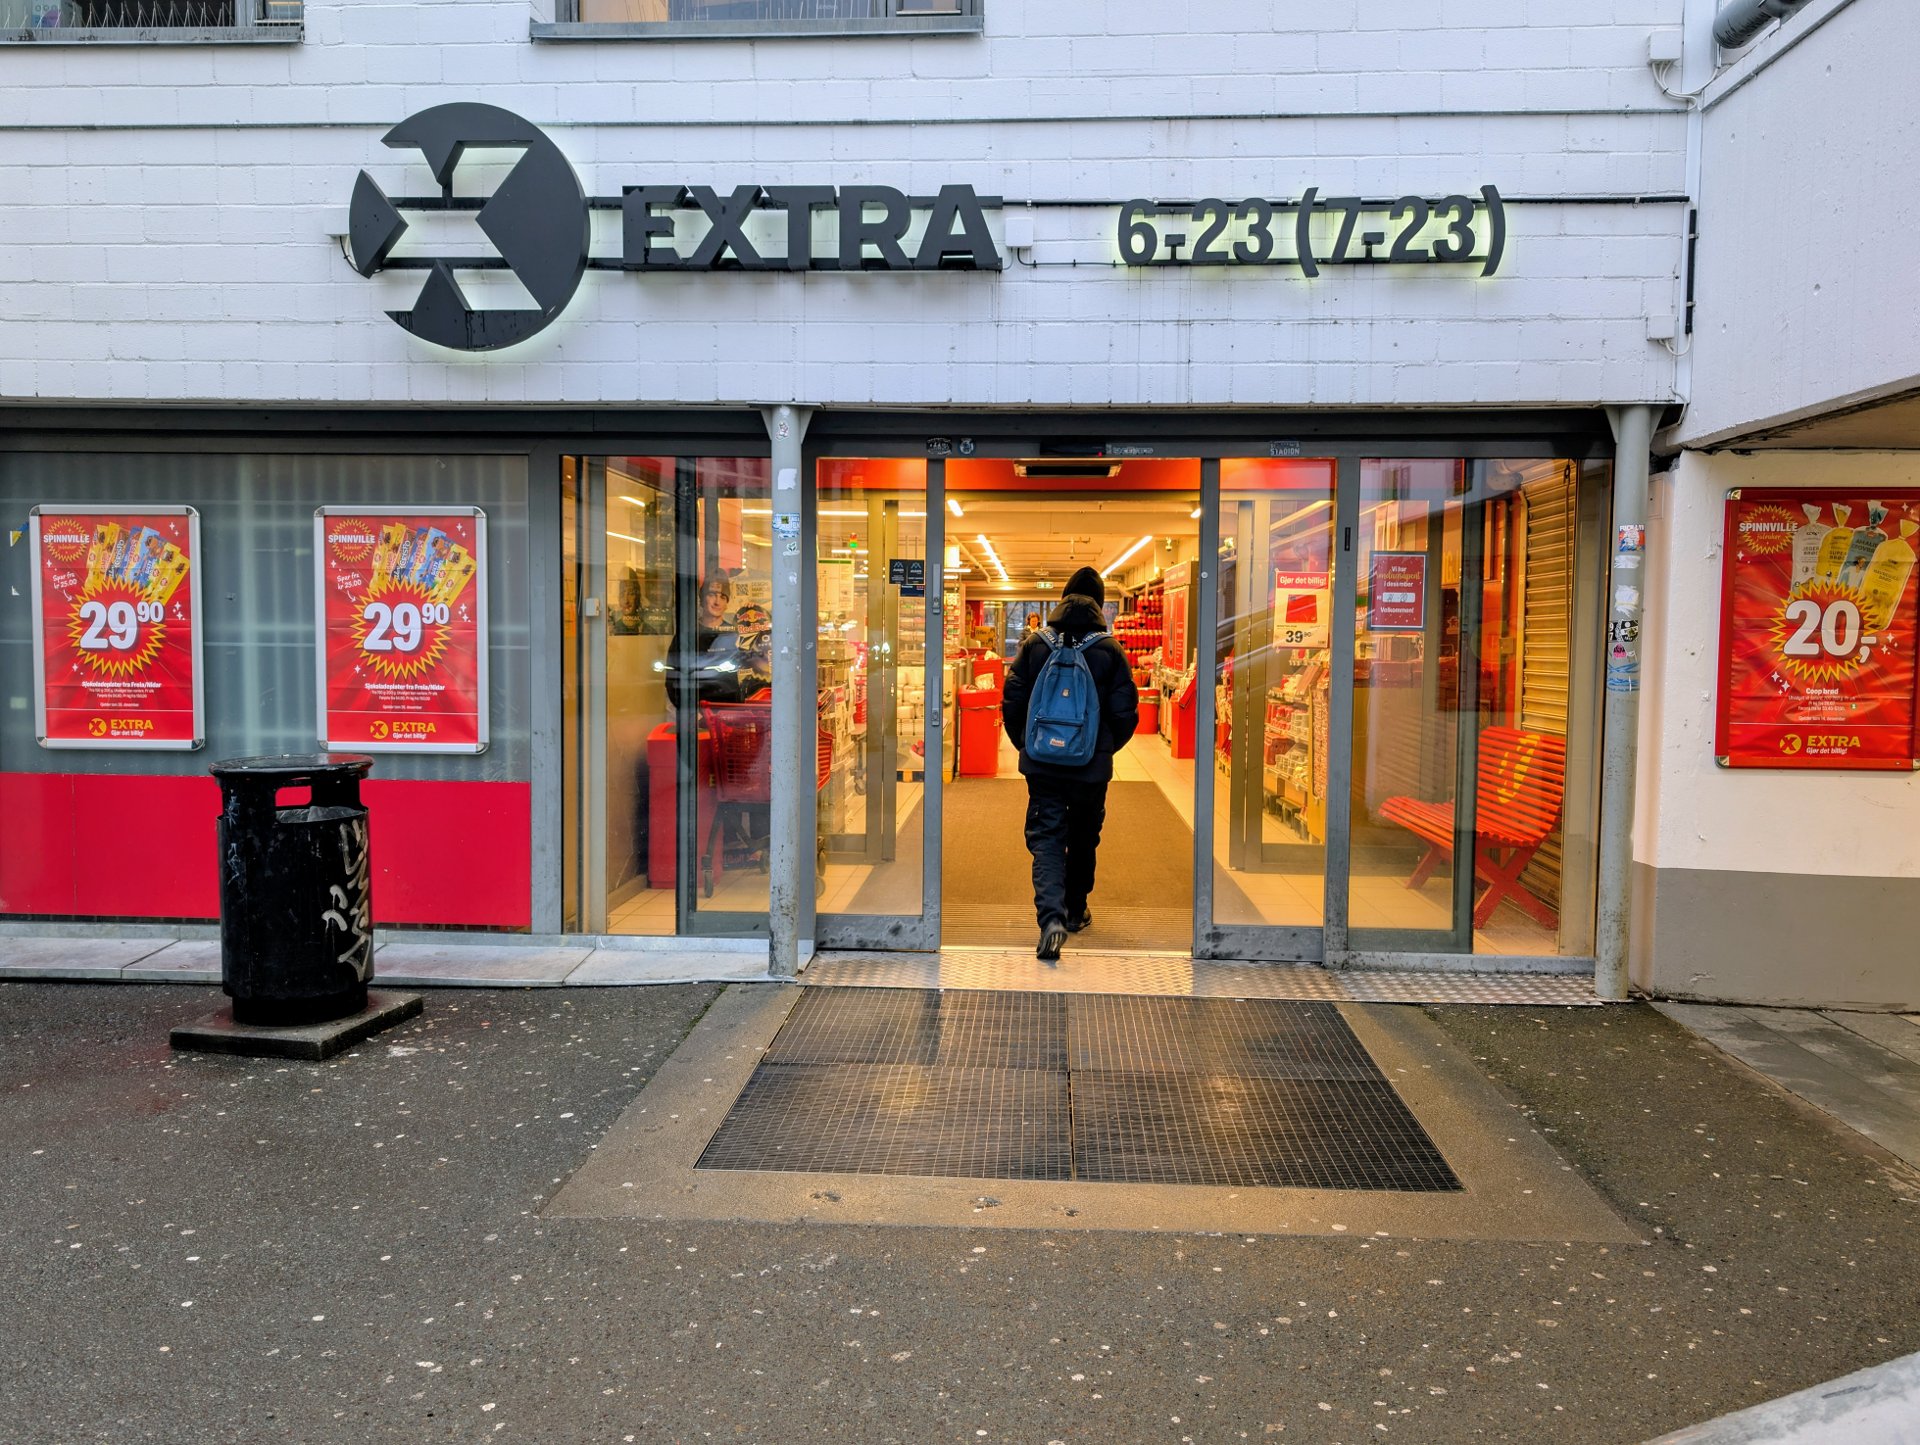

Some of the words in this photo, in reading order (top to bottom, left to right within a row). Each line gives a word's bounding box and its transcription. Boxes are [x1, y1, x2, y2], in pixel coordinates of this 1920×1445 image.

[622, 184, 1003, 271] EXTRA
[1118, 197, 1274, 266] 6-23
[1296, 184, 1507, 278] (7-23)
[1739, 522, 1798, 532] SPINNVILLE
[43, 534, 90, 544] SPINNVILLE
[328, 534, 376, 544] SPINNVILLE
[1280, 576, 1294, 585] Gjør
[1308, 577, 1326, 586] billig!
[79, 602, 138, 651] 29
[137, 601, 164, 623] 90
[364, 602, 422, 652] 29
[422, 603, 450, 625] 90
[1286, 630, 1303, 643] 39
[111, 719, 154, 729] EXTRA
[392, 722, 436, 732] EXTRA
[1807, 736, 1860, 747] EXTRA
